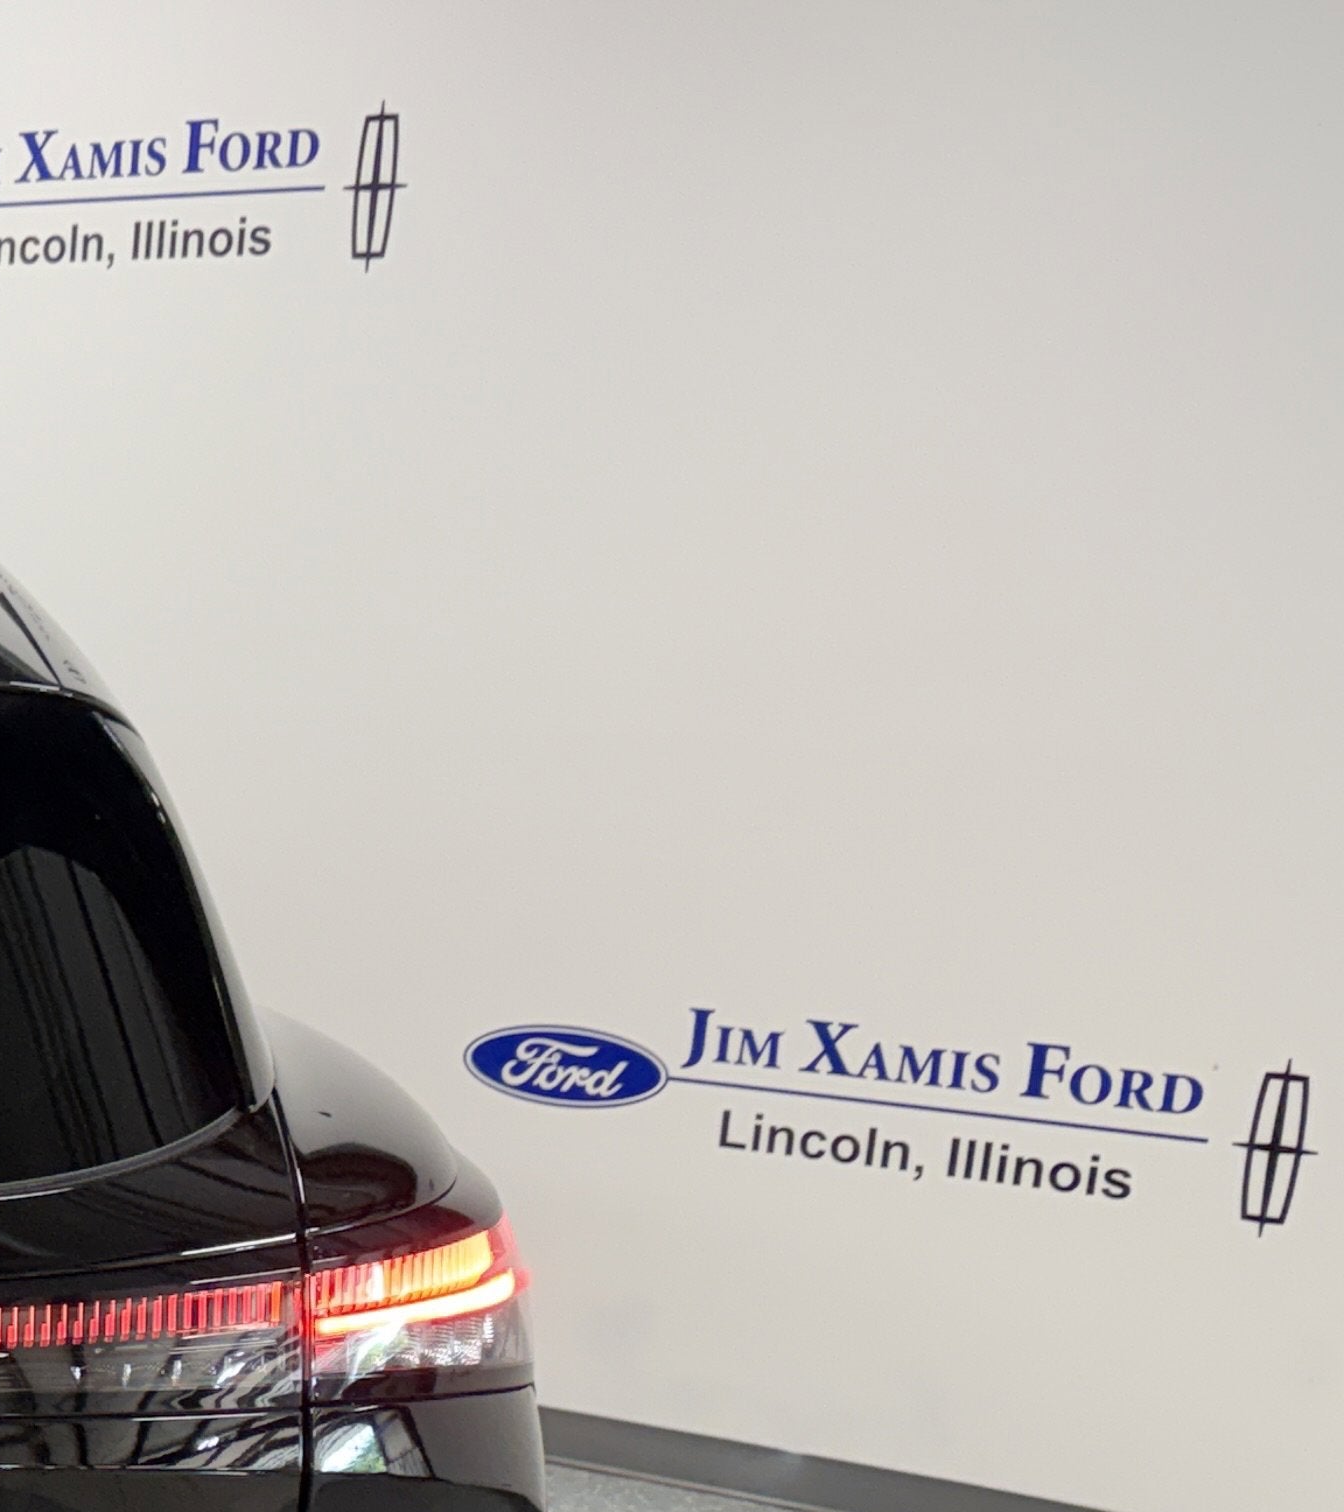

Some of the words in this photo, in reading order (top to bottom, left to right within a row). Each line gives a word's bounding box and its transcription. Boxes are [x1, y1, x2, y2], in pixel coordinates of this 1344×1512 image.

[14, 130, 167, 184] XAMIS
[182, 118, 320, 173] FORD
[130, 217, 271, 259] Illinois
[500, 1036, 628, 1098] Ford
[681, 1008, 785, 1069] JIM
[799, 1018, 1001, 1094] XAMIS
[1019, 1042, 1204, 1116] FORD
[718, 1109, 924, 1180] Lincoln,
[946, 1136, 1134, 1201] Illinois
